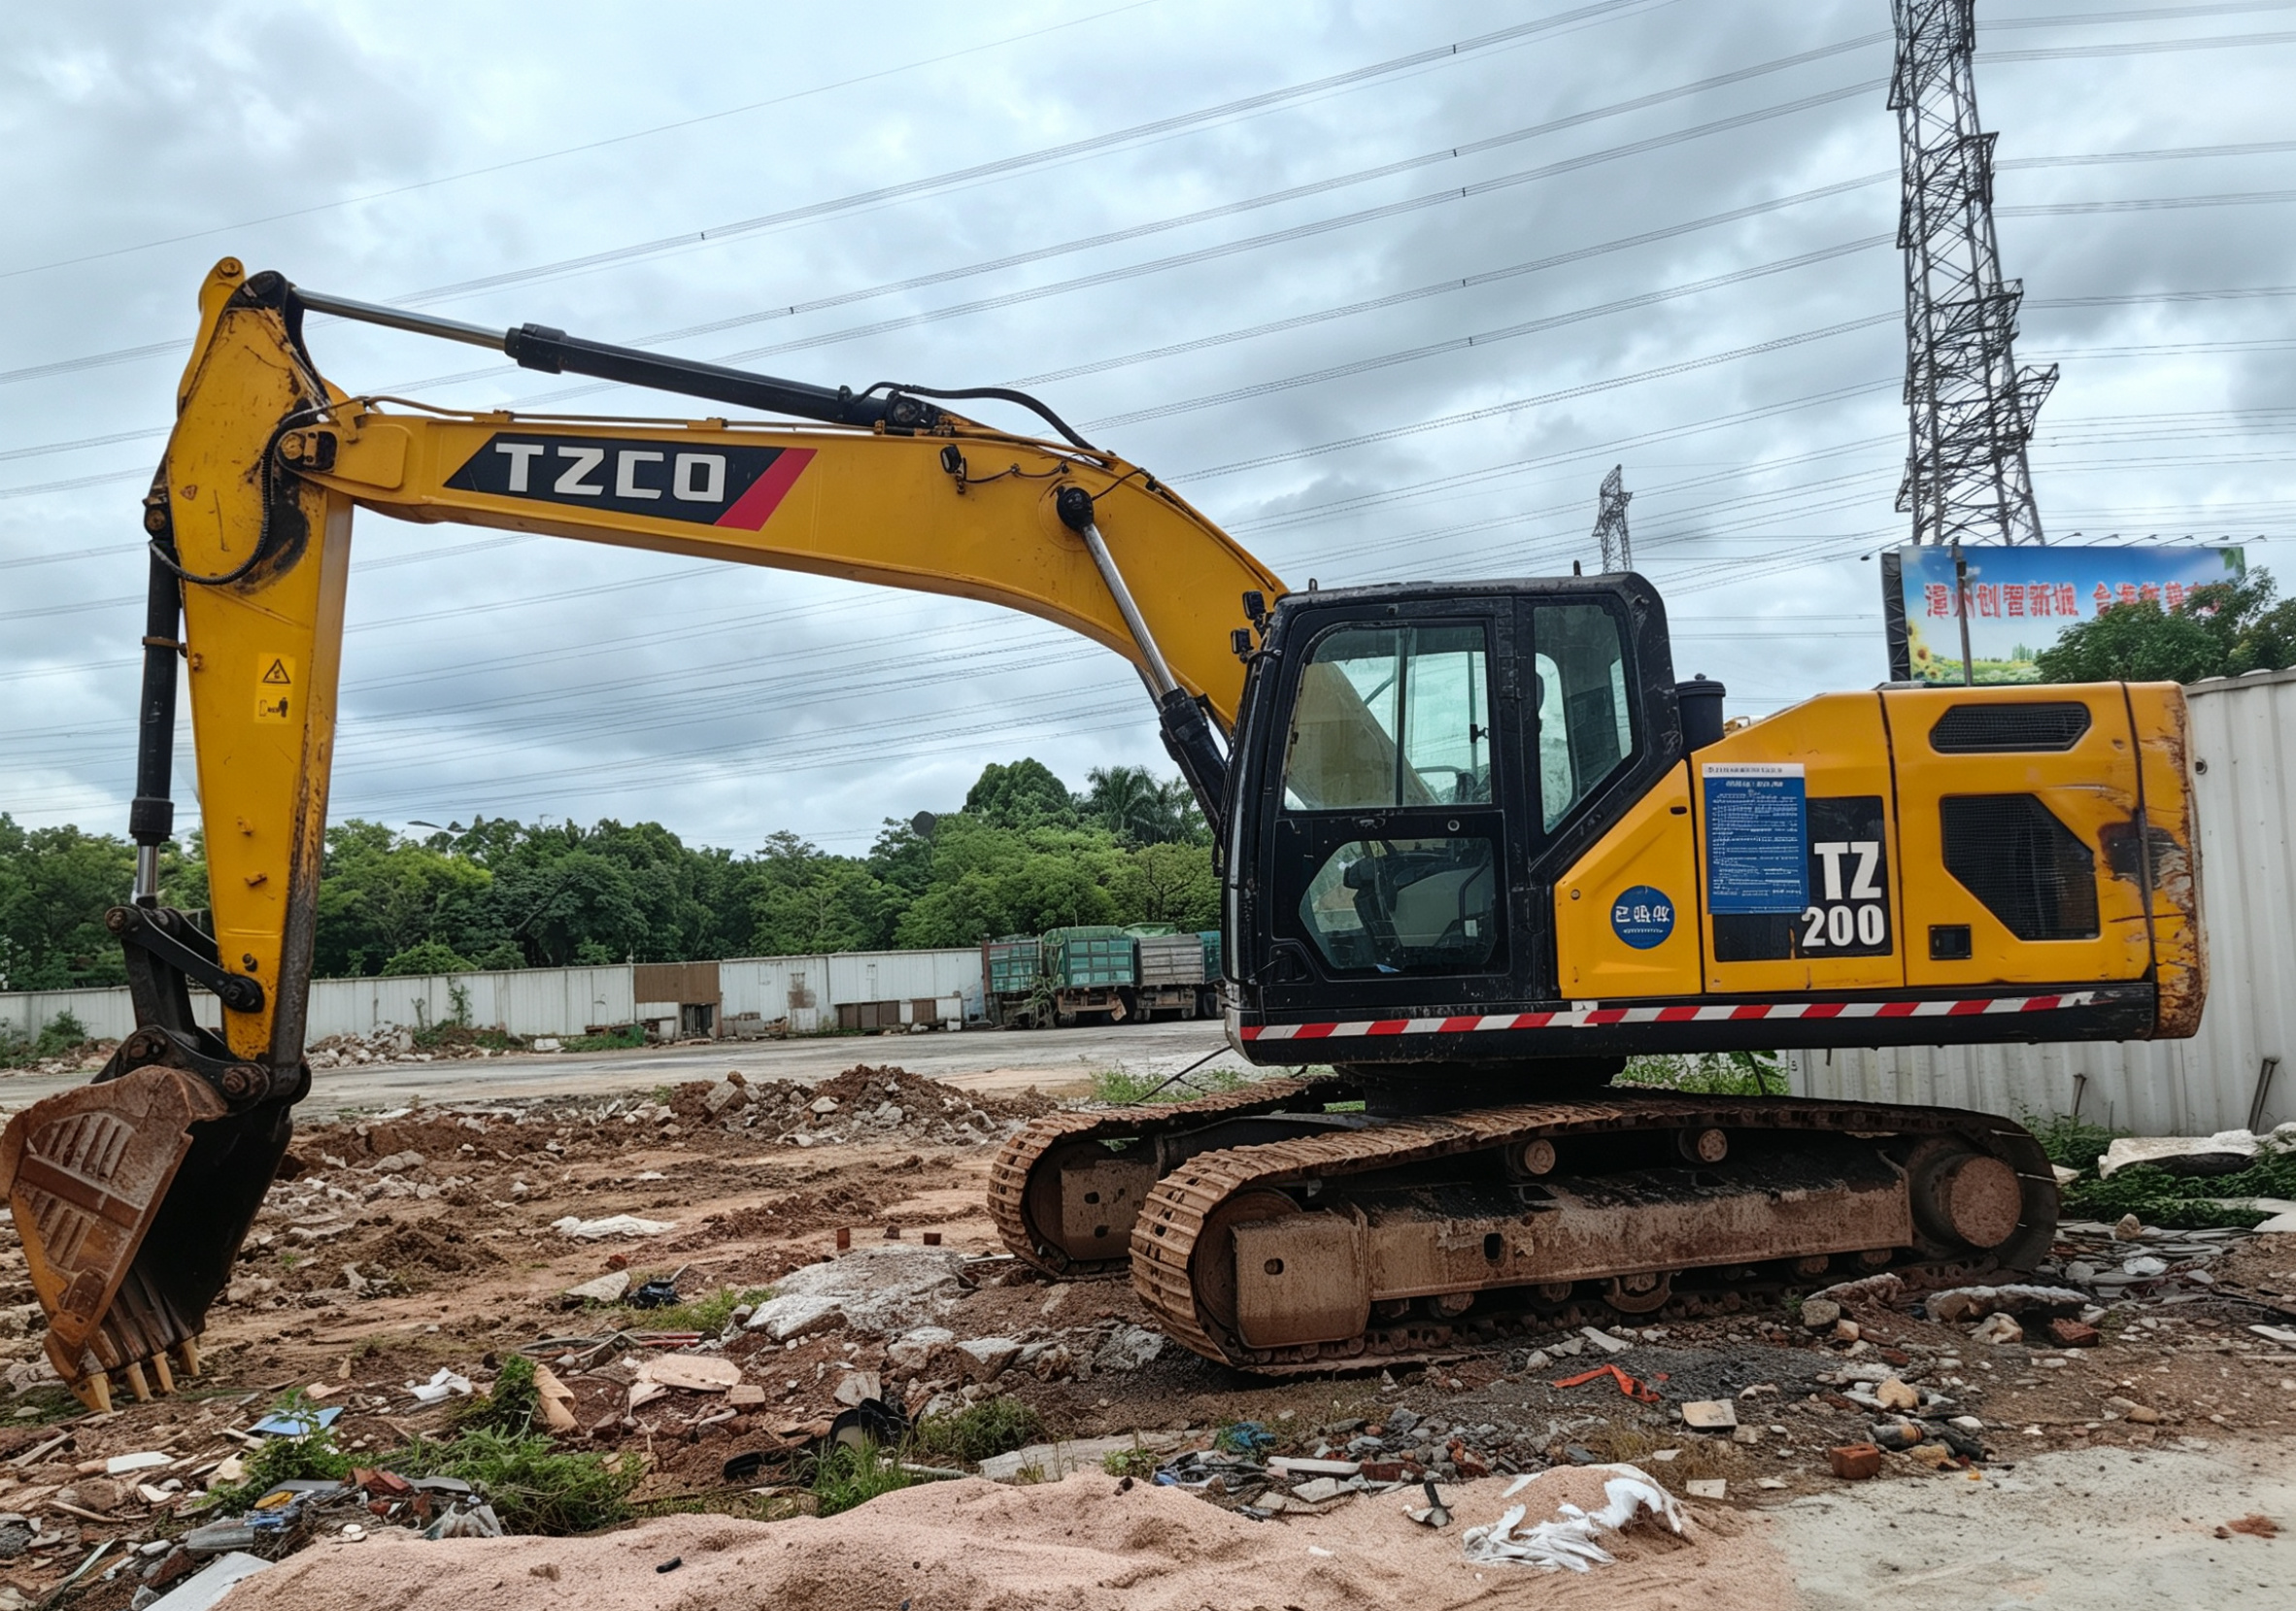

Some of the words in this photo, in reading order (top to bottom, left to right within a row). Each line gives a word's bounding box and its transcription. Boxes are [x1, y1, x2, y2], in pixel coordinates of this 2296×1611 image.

[495, 442, 726, 503] TZCO
[1813, 841, 1882, 900] TZ
[1801, 904, 1885, 947] 200
